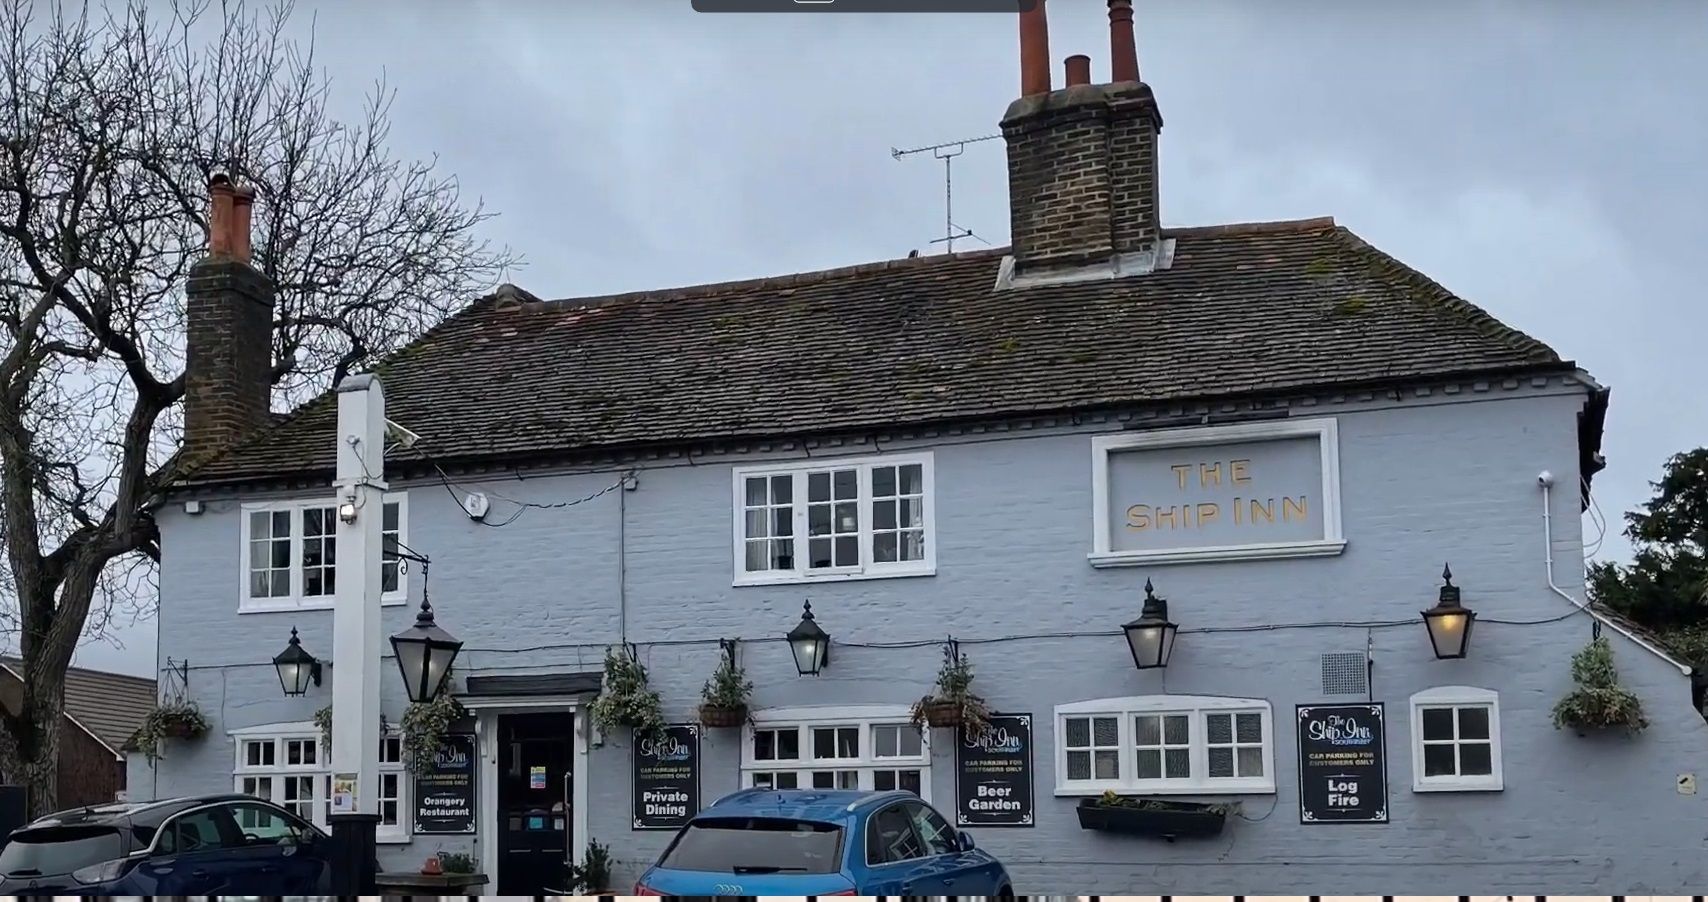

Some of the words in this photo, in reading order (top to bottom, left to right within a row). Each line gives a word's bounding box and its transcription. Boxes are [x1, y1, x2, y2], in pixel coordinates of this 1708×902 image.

[1171, 459, 1251, 489] THE
[1126, 503, 1220, 533] SHIP
[1233, 496, 1307, 526] INN
[1327, 715, 1345, 726] The
[994, 727, 1020, 747] Inn
[1308, 720, 1340, 745] Ship
[1341, 718, 1371, 739] Inn
[977, 785, 1012, 797] Beer
[1328, 780, 1358, 794] Log
[424, 797, 465, 806] Orangery
[643, 791, 689, 802] Private
[1328, 794, 1359, 806] Fire
[646, 804, 686, 816] Dining
[968, 798, 1021, 810] Garden
[420, 808, 469, 816] Restaurant
